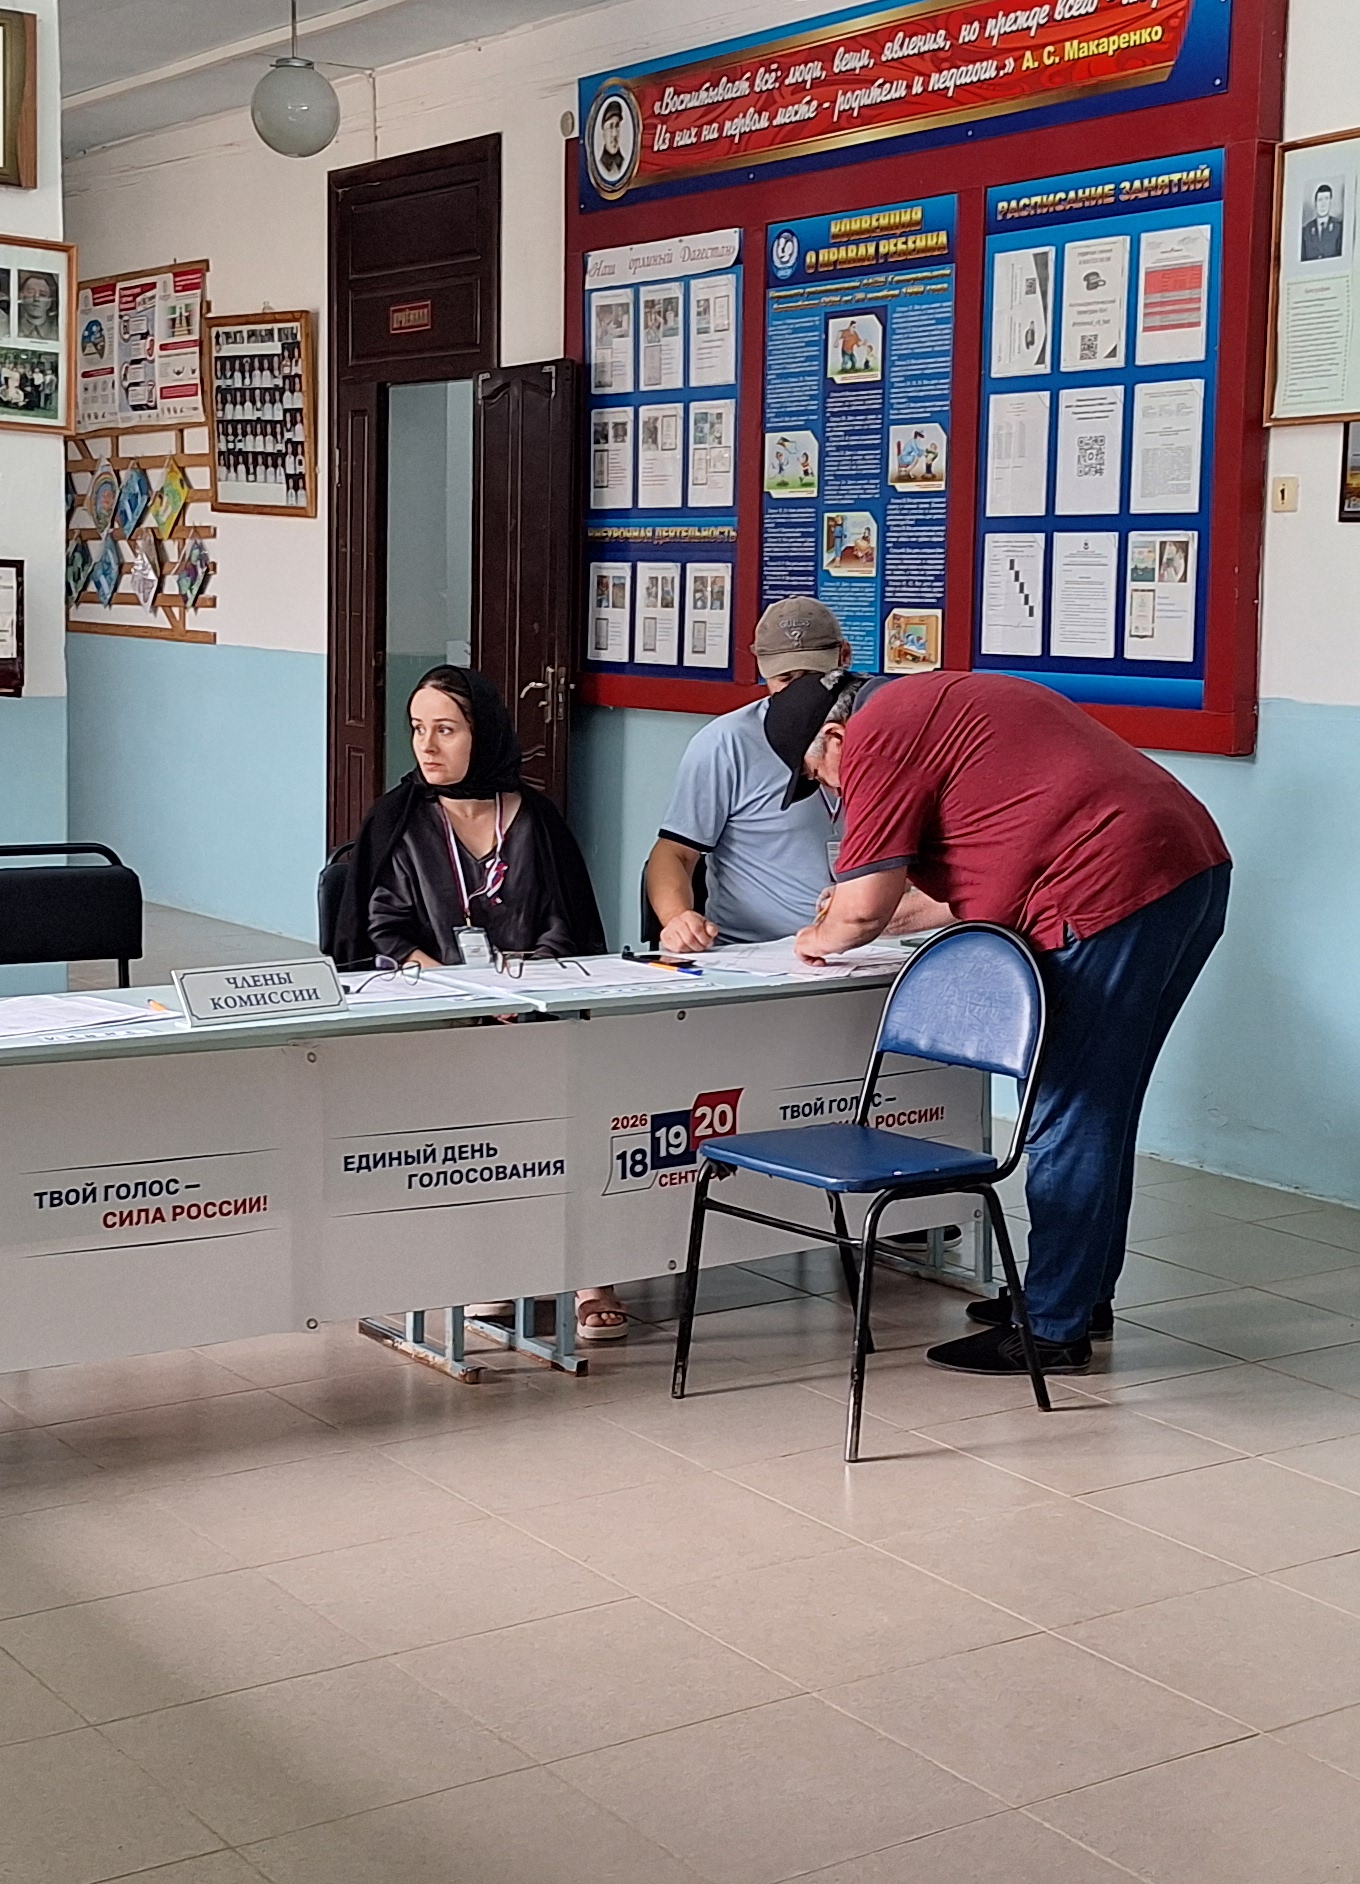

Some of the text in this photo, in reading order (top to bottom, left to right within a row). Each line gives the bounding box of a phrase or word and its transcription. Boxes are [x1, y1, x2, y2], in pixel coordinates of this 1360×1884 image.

[654, 73, 750, 116] «Воспитывает
[784, 60, 826, 87] люди,
[833, 47, 875, 74] вещи,
[881, 28, 951, 62] явления,
[958, 22, 980, 44] но
[984, 4, 1048, 47] прежде
[653, 123, 669, 152] Из
[673, 130, 697, 149] них
[700, 123, 719, 141] на
[723, 111, 769, 143] первом
[772, 95, 818, 127] месте
[833, 76, 907, 122] родители
[911, 76, 924, 95] и
[1022, 50, 1038, 71] А.
[1042, 45, 1060, 65] С.
[1064, 24, 1163, 62] Макаренко
[996, 164, 1211, 221] РАСПИСАНИЕ ЗАНЯТИЙ
[225, 971, 294, 990] ЧЛЕНЫ
[209, 988, 321, 1010] КОМИССИИ
[779, 1097, 824, 1120] ТВОЙ
[828, 1092, 882, 1115] ГОЛС
[875, 1106, 945, 1129] РОССИИ!
[611, 1114, 648, 1131] 2026
[616, 1103, 733, 1180] 18 19 20
[343, 1142, 498, 1173] ЕДИНЫЙ ДЕНЬ
[407, 1159, 565, 1190] ГОЛОСОВАНИЯ
[33, 1182, 97, 1210] ТВОЙ
[103, 1178, 180, 1202] ГОЛОС
[102, 1195, 268, 1229] СИЛА РОССИИ!
